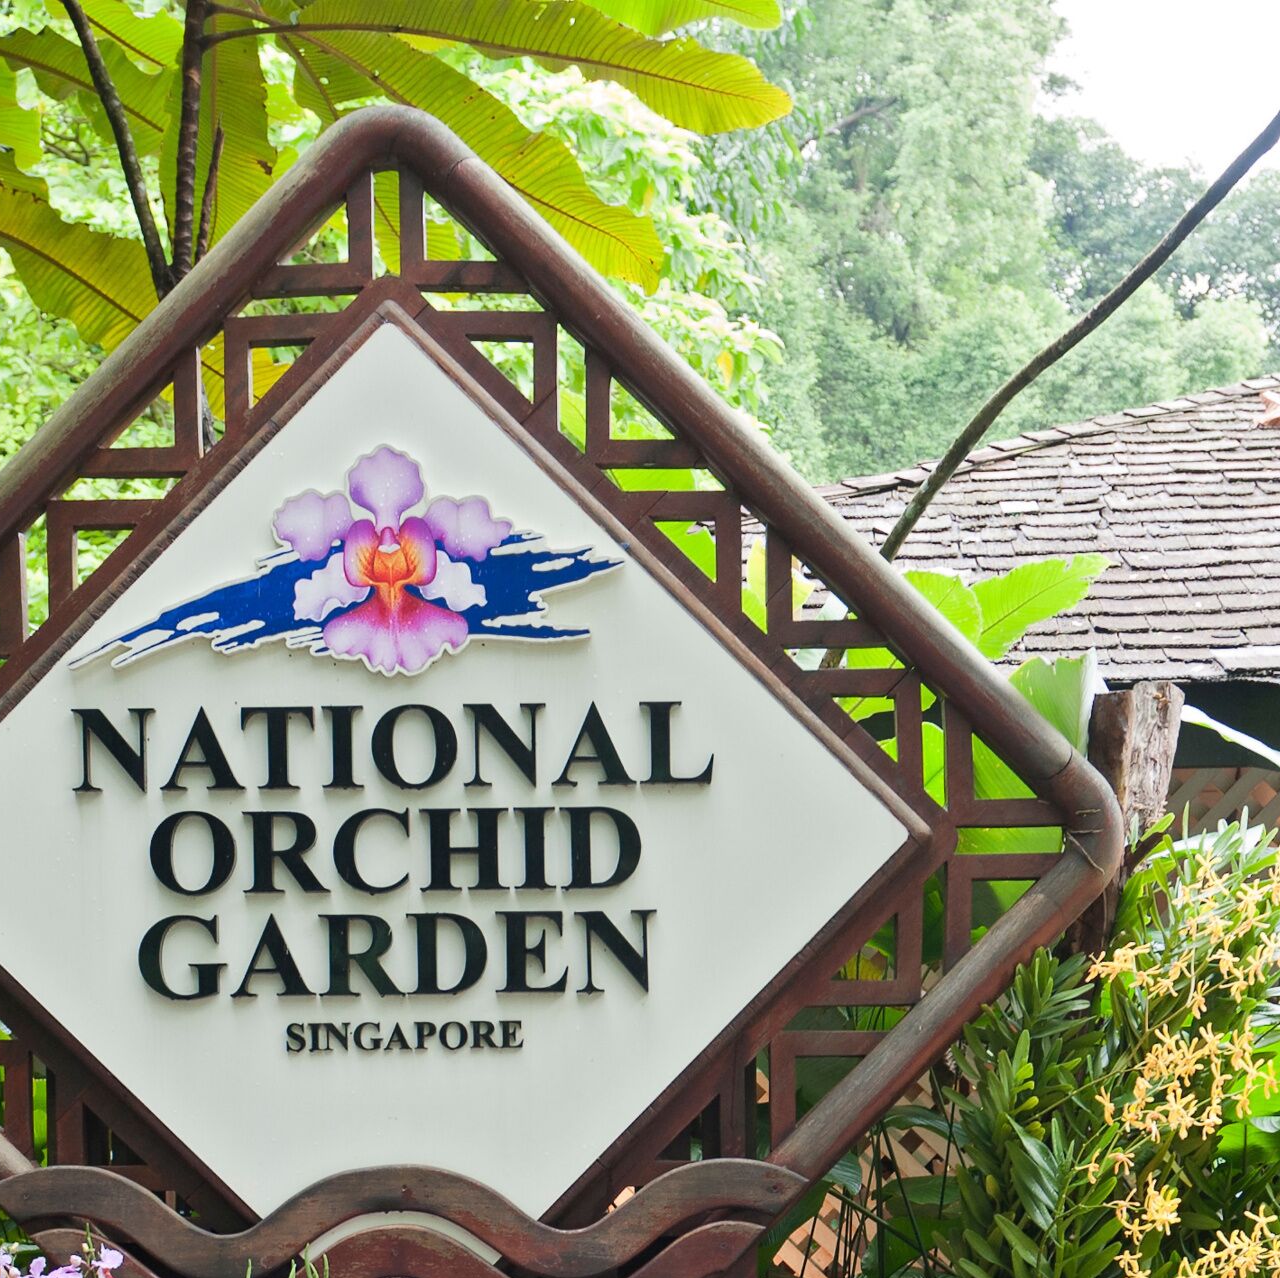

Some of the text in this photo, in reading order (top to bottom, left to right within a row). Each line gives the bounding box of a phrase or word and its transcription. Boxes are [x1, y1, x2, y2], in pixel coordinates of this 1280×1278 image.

[71, 701, 715, 796] NATIONAL
[149, 806, 642, 899] ORCHID
[138, 909, 657, 1002] GARDEN
[285, 1020, 524, 1055] SINGAPORE
